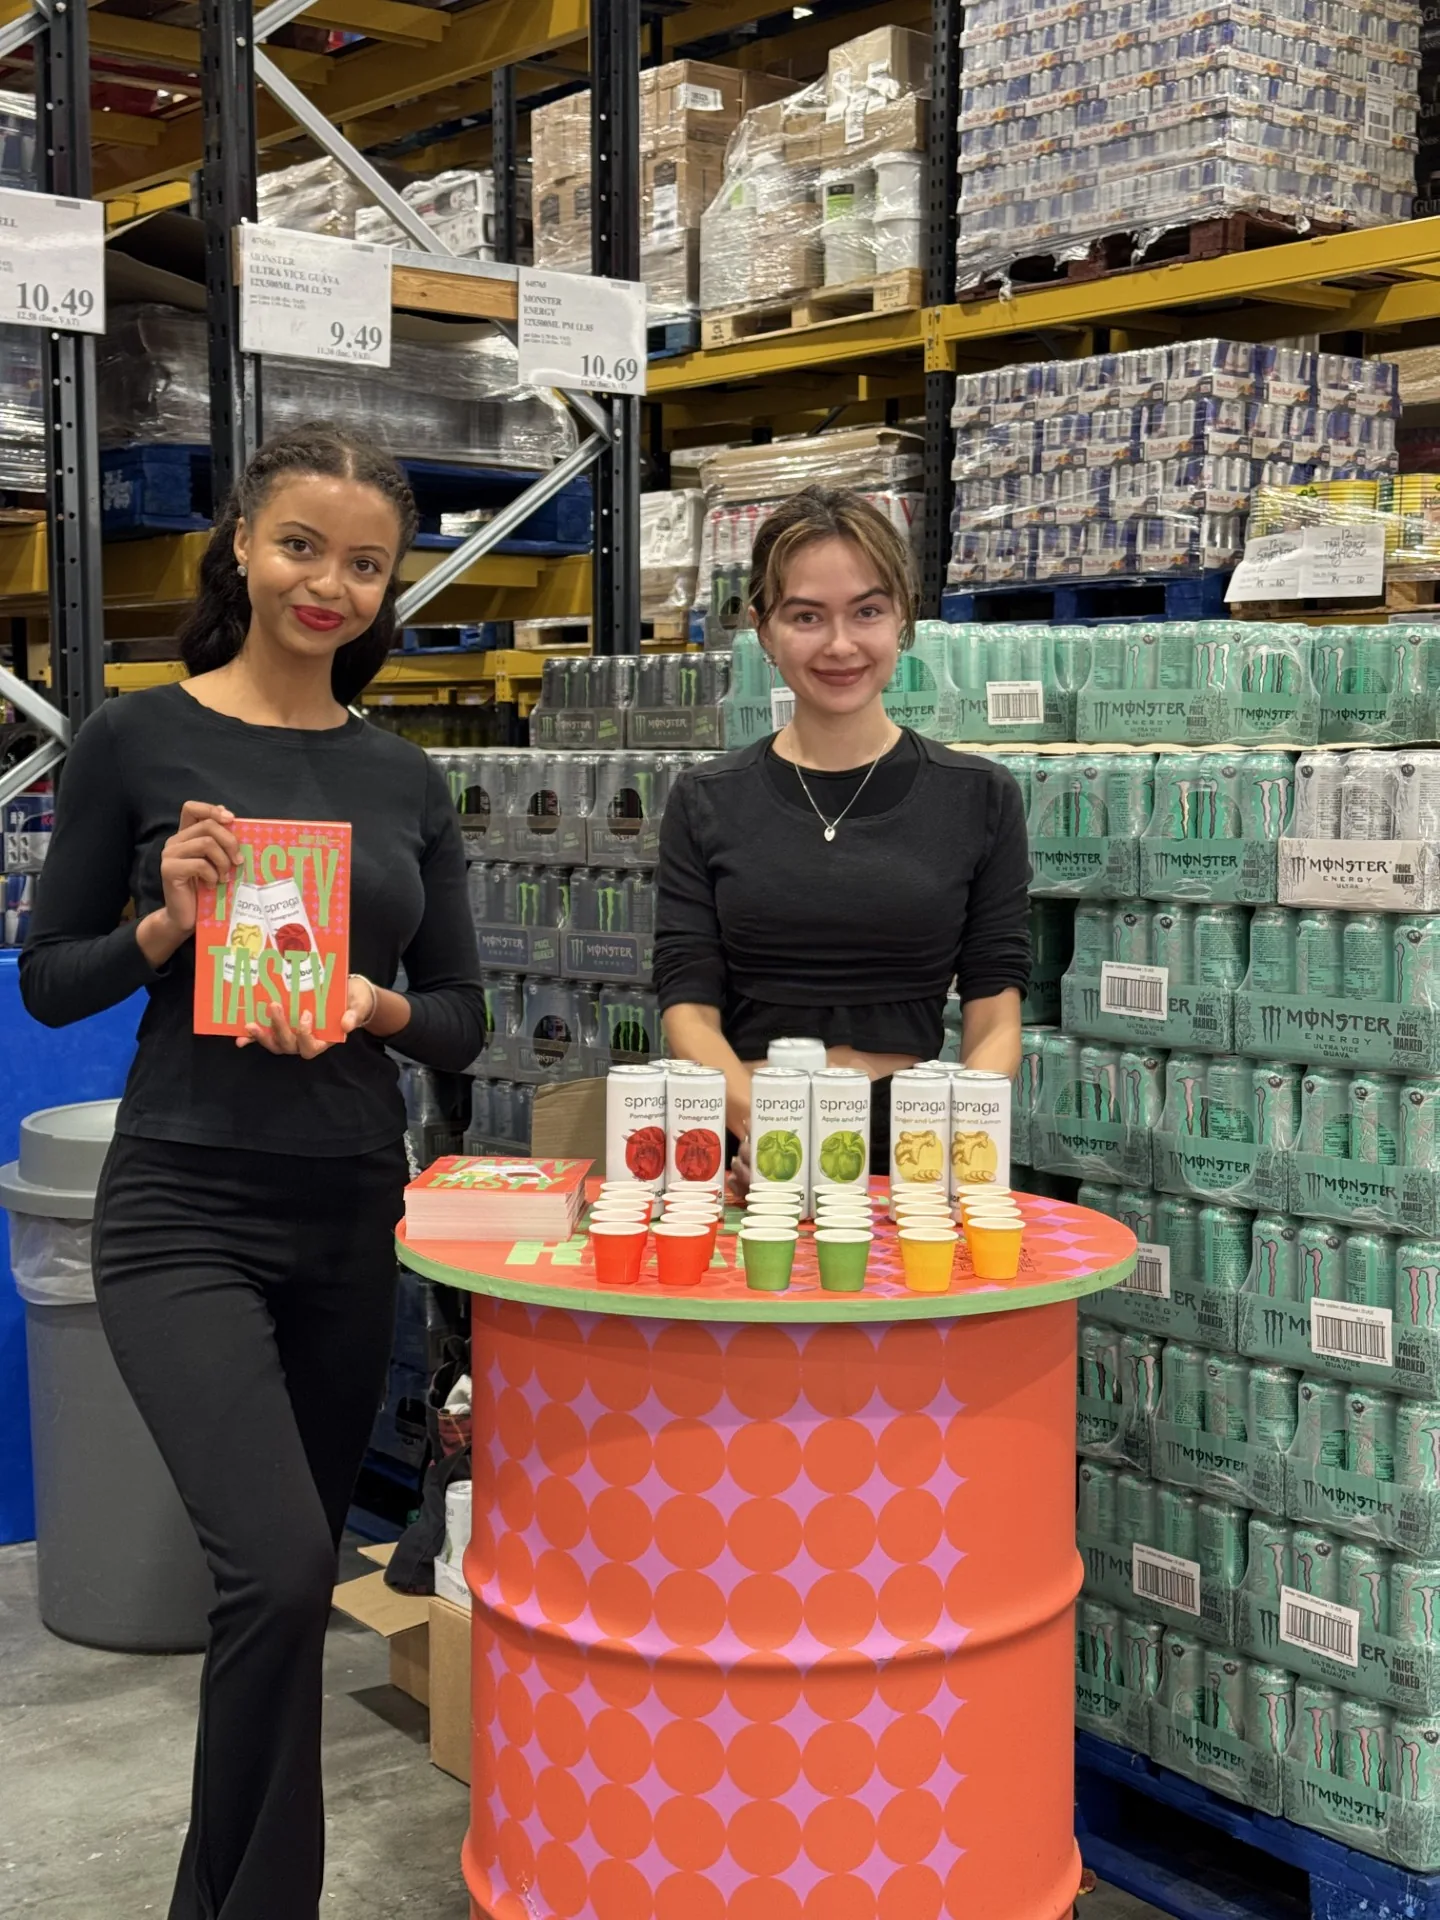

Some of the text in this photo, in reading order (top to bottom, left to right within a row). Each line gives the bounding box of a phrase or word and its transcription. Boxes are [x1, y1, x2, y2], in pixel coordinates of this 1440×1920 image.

[251, 252, 295, 266] MONSTER
[249, 265, 282, 277] ULTRA
[284, 269, 306, 280] VICE
[295, 282, 309, 293] PM
[16, 282, 94, 317] 10.49
[524, 295, 562, 306] MONSTER
[524, 306, 556, 316] ENERGY
[524, 318, 560, 329] 12X500ML
[562, 322, 575, 330] PM
[330, 321, 382, 351] 9.49
[580, 354, 638, 381] 10.69
[1111, 699, 1187, 717] MONSTER
[1331, 708, 1387, 721] MONSTER
[648, 715, 687, 728] MONSTER
[1045, 851, 1102, 865] MONSTER
[1171, 852, 1238, 869] MONSTER
[1309, 857, 1389, 874] MONSTER
[1395, 863, 1411, 874] PRICE
[1323, 875, 1372, 883] ENERGY
[1392, 874, 1414, 885] MARKED
[482, 935, 525, 949] MONSTER
[587, 944, 633, 959] MONSTER
[208, 946, 337, 1030] TASTY
[1195, 1003, 1214, 1017] PRICE
[1192, 1017, 1217, 1031] MARKED
[1286, 1008, 1393, 1036] MONSTER
[1396, 1023, 1418, 1038] PRICE
[1305, 1032, 1372, 1045] ENERGY
[1393, 1037, 1422, 1052] MARKED
[1313, 1043, 1359, 1053] ULTRA VICE
[1323, 1050, 1350, 1059] GUAVA
[674, 1097, 723, 1111] spraga
[755, 1097, 806, 1112] spraga
[819, 1098, 868, 1113] spraga
[895, 1100, 946, 1115] spraga
[757, 1115, 775, 1123] Apple
[822, 1115, 838, 1124] Apple
[1061, 1134, 1121, 1153] MONSTER
[1184, 1153, 1251, 1174] MONSTER
[427, 1173, 566, 1191] TASTY
[1323, 1176, 1398, 1200] MONSTER
[1124, 1298, 1180, 1316] ENERGY
[1200, 1300, 1219, 1315] PRICE
[1198, 1312, 1223, 1328] MARKED
[1398, 1341, 1421, 1358] PRICE
[1325, 1361, 1352, 1372] GUAVA
[1394, 1354, 1426, 1374] MARKED
[1311, 1658, 1357, 1678] ULTRA VICE
[1392, 1656, 1414, 1673] PRICE
[1320, 1666, 1348, 1681] GUAVA
[1389, 1669, 1420, 1689] MARKED
